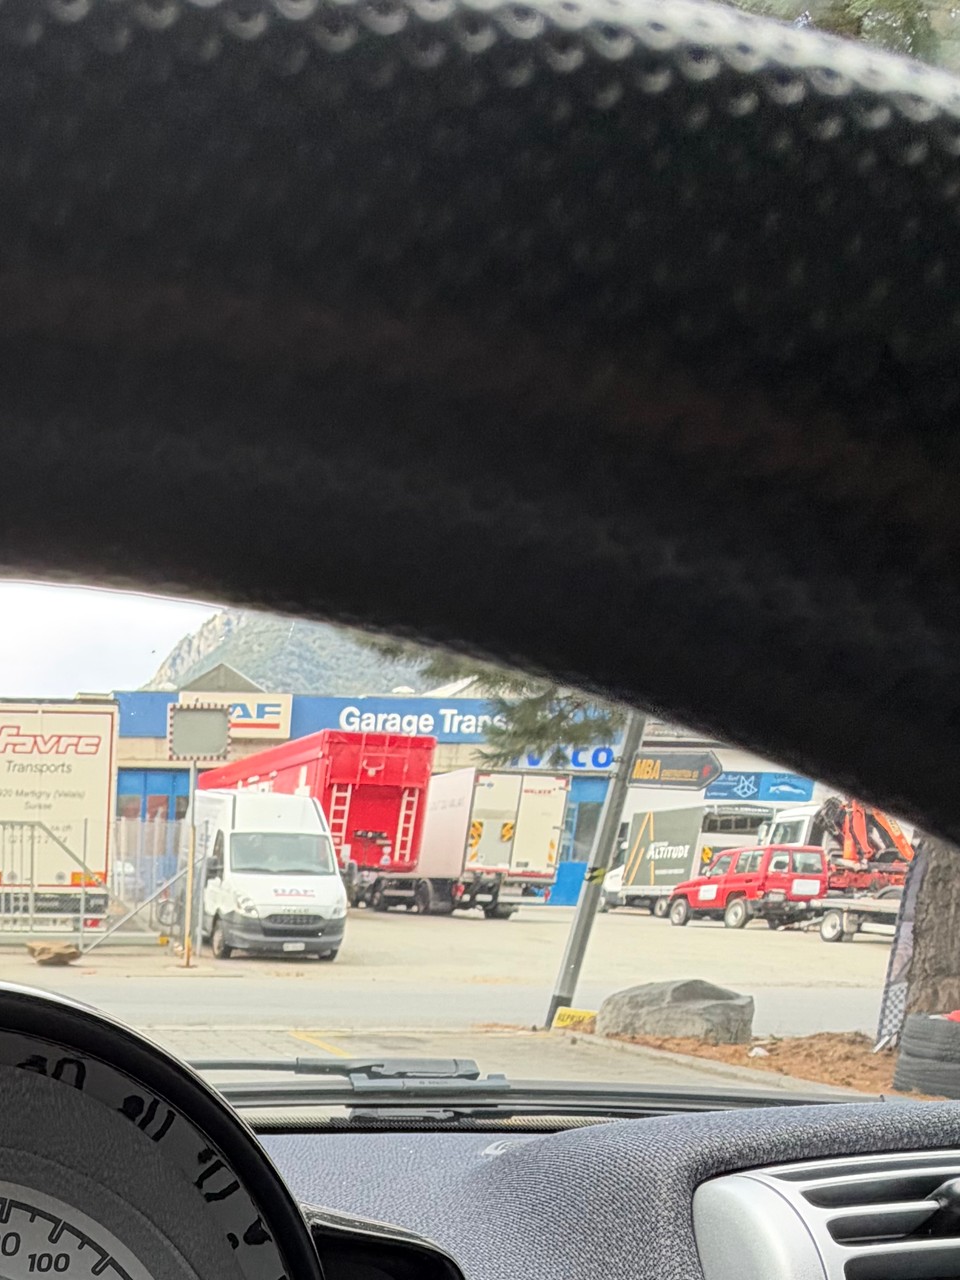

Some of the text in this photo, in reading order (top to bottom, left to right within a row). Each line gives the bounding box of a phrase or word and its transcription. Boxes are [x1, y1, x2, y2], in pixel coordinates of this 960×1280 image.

[230, 703, 281, 719] AF
[339, 706, 515, 737] Garage Trans
[6, 760, 72, 775] Transports
[632, 758, 662, 780] MBA
[28, 1253, 70, 1273] 100
